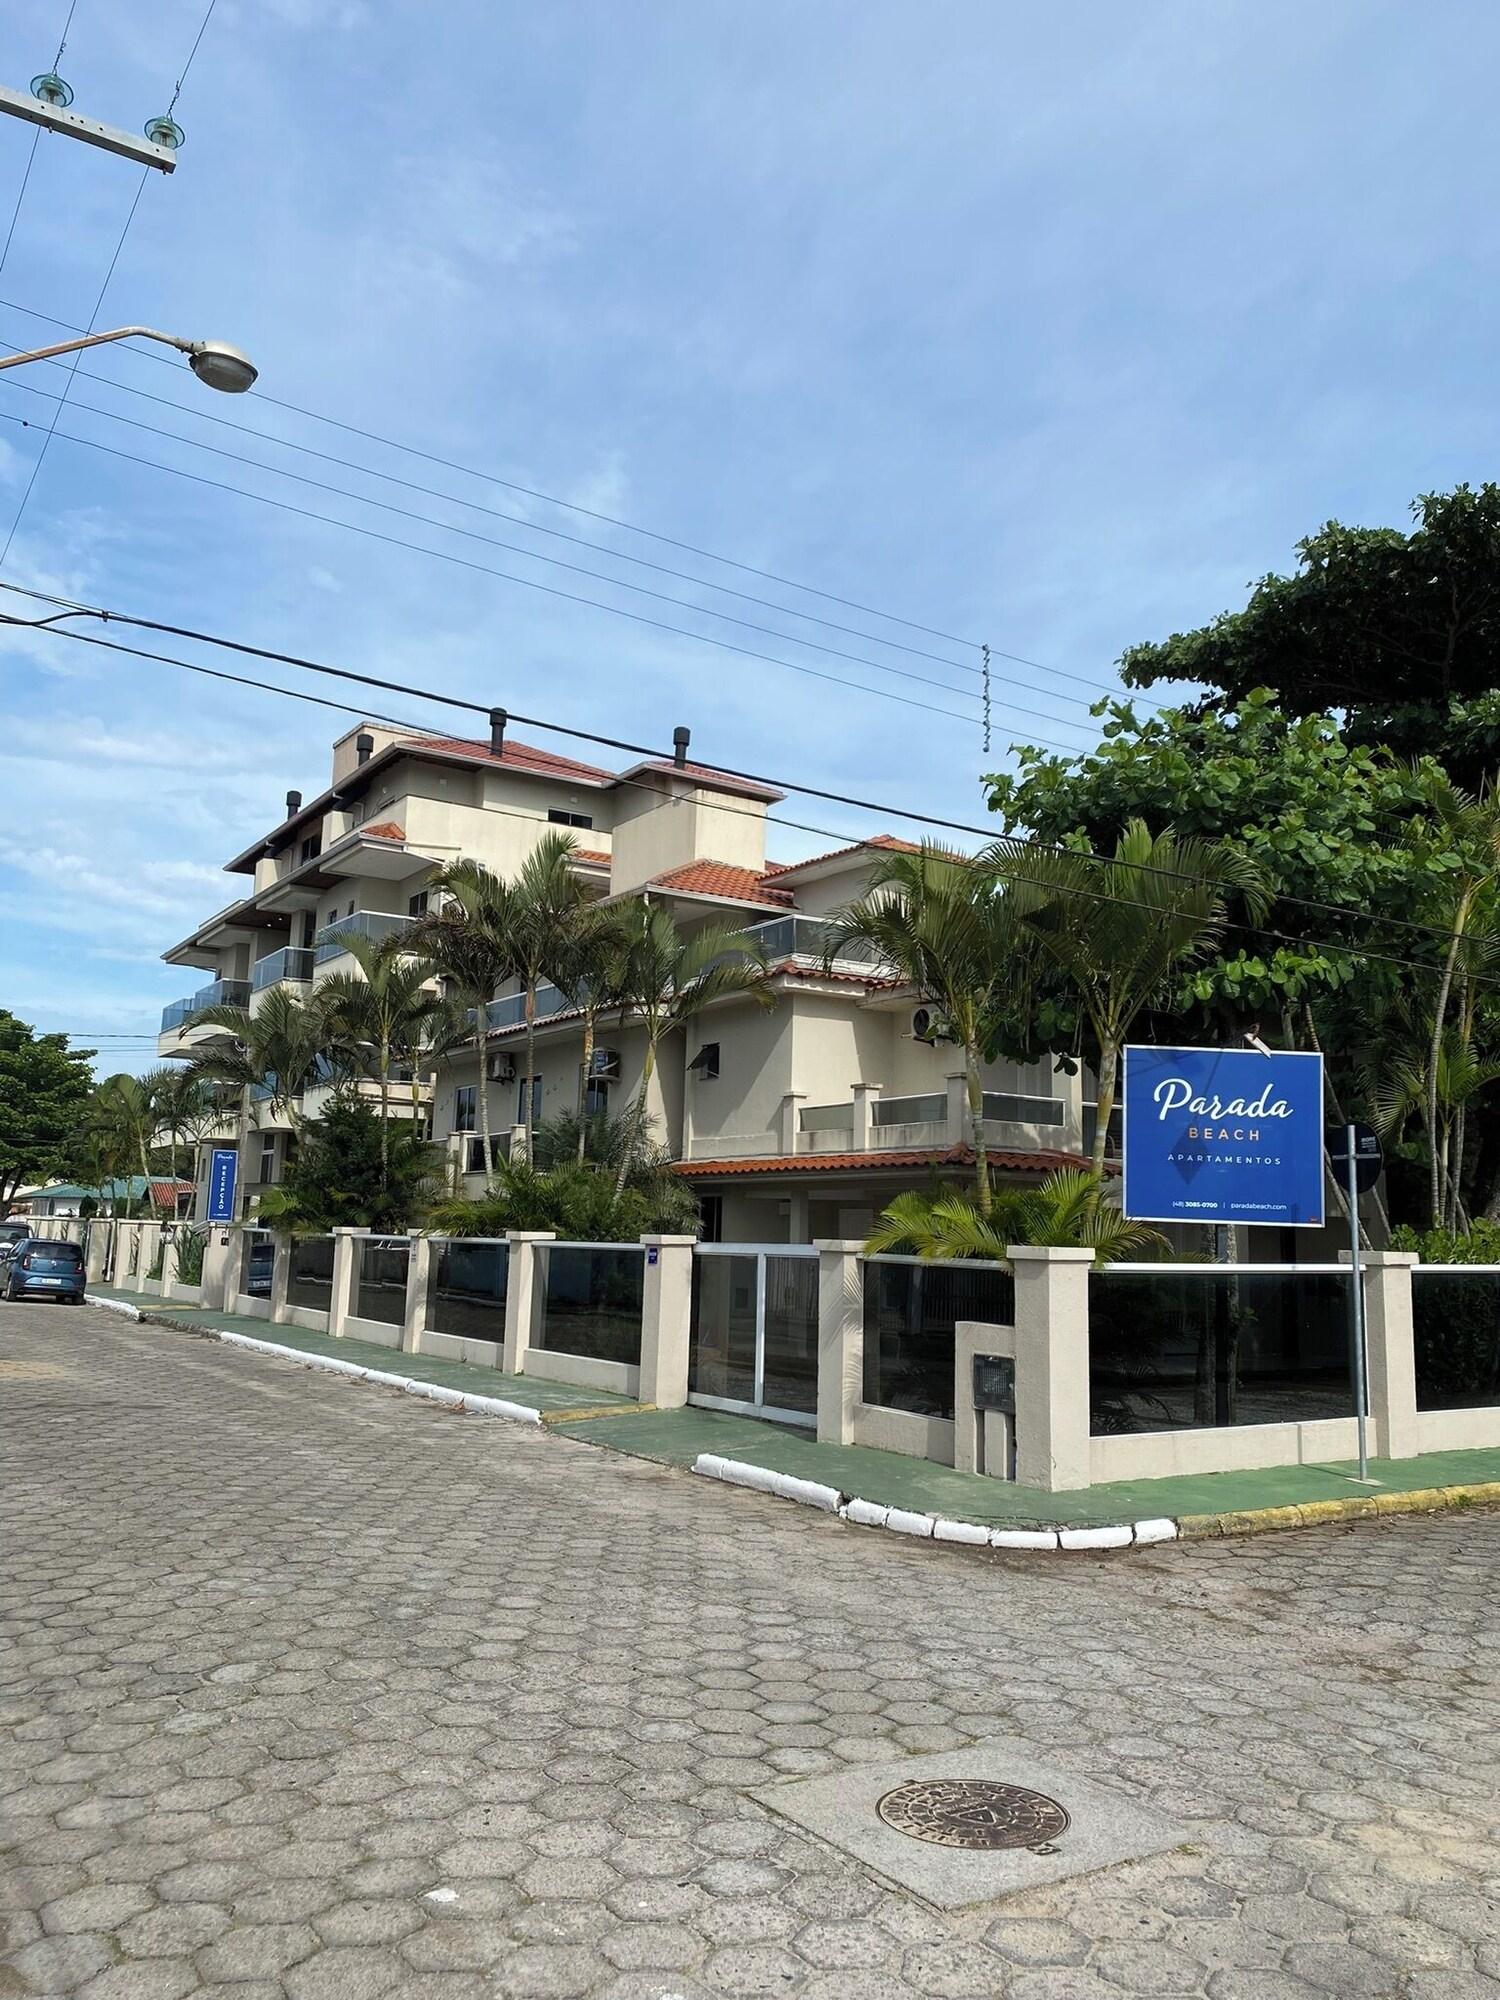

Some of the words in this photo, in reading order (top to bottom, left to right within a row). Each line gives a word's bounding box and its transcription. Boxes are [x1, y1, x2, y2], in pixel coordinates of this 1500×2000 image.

[1153, 1078, 1294, 1121] Parada
[1188, 1127, 1260, 1141] BEACH
[1167, 1153, 1281, 1165] APARTAMENTOS
[1230, 1202, 1287, 1211] paradabeach.com
